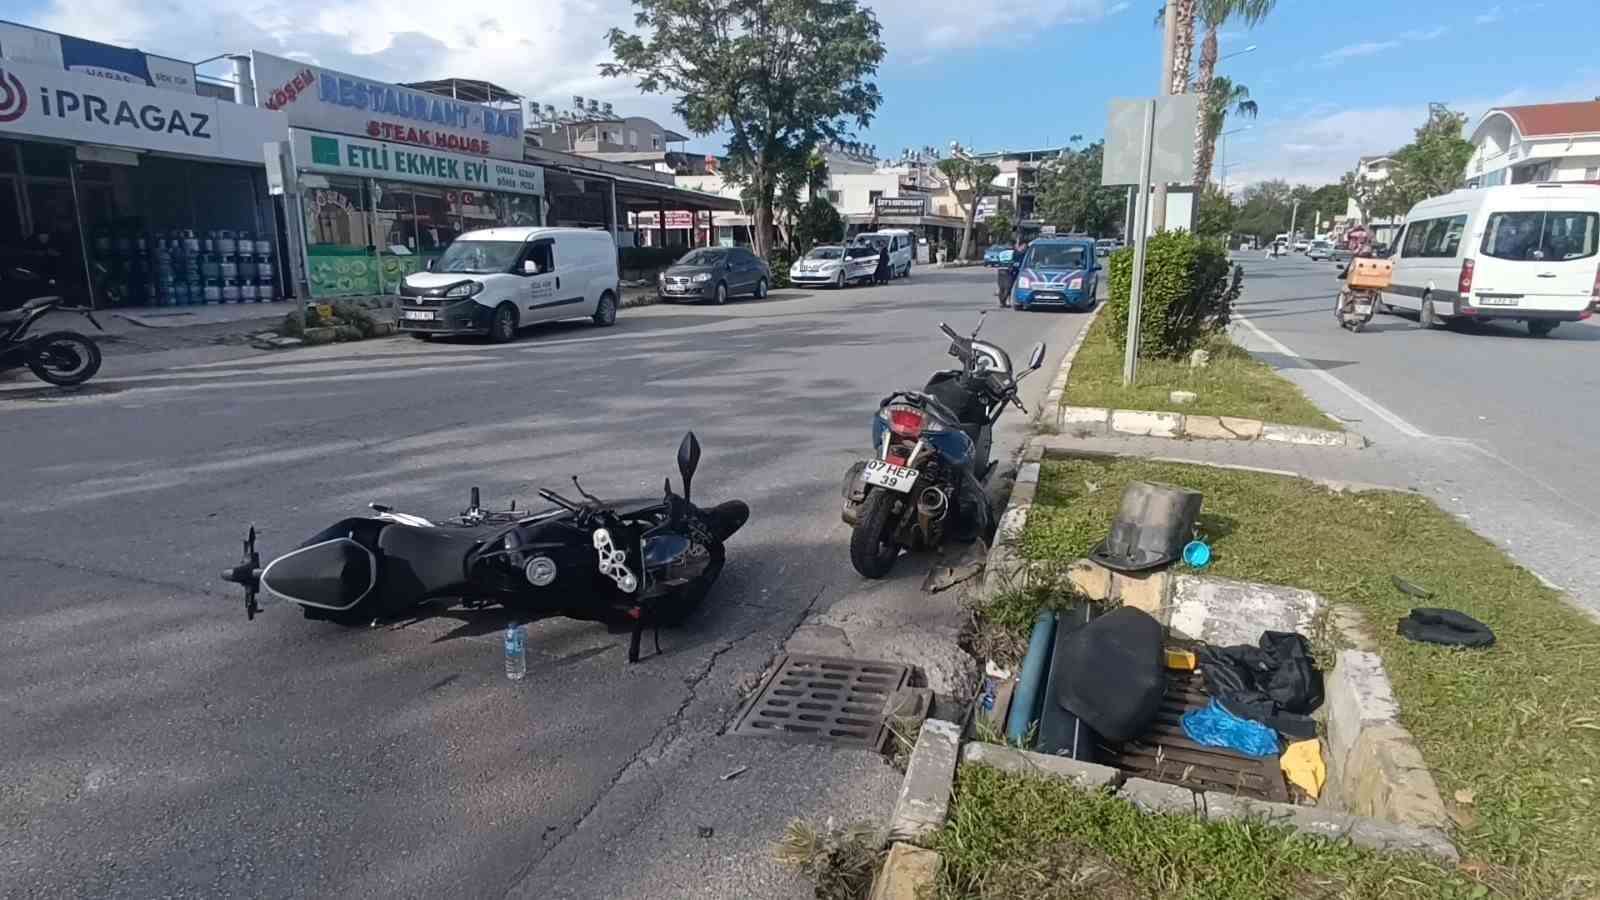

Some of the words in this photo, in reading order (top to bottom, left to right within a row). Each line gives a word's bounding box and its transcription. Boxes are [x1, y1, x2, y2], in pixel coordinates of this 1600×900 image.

[318, 72, 468, 129] RESTAURANT
[482, 108, 520, 138] BAR
[367, 120, 430, 145] STEAK
[435, 132, 490, 155] HOUSE
[347, 144, 389, 171] ETLİ
[395, 151, 459, 179] EKMEK
[463, 160, 489, 183] EVİ
[868, 460, 886, 471] 07
[886, 464, 917, 479] HEP
[879, 475, 898, 487] 39
